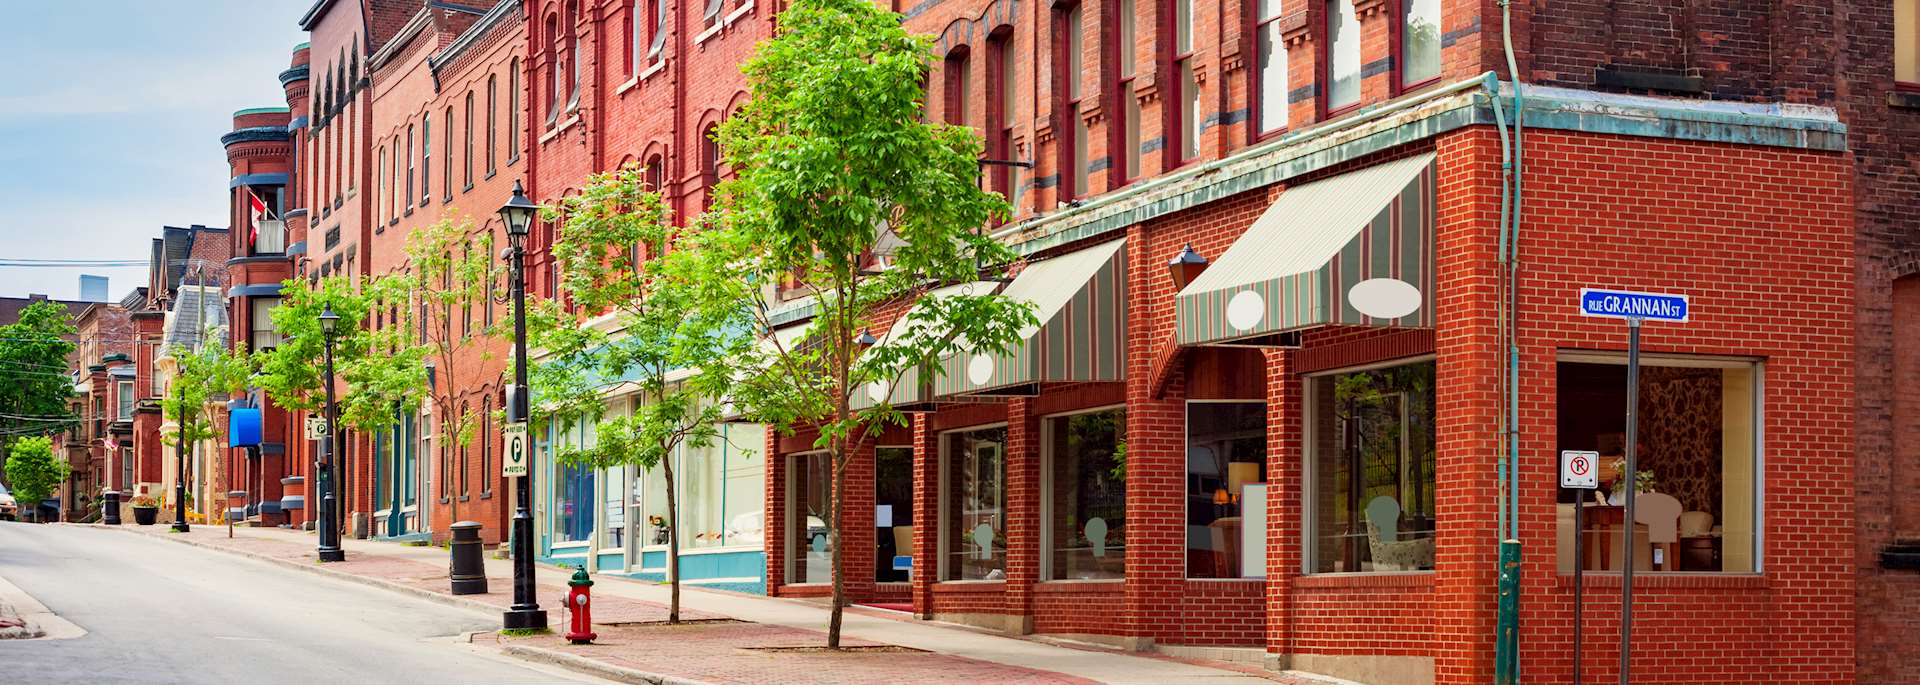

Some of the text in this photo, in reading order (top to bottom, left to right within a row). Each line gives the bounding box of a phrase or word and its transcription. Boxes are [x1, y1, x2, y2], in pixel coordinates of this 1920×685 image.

[1588, 295, 1681, 317] RUE GRANNAN ST
